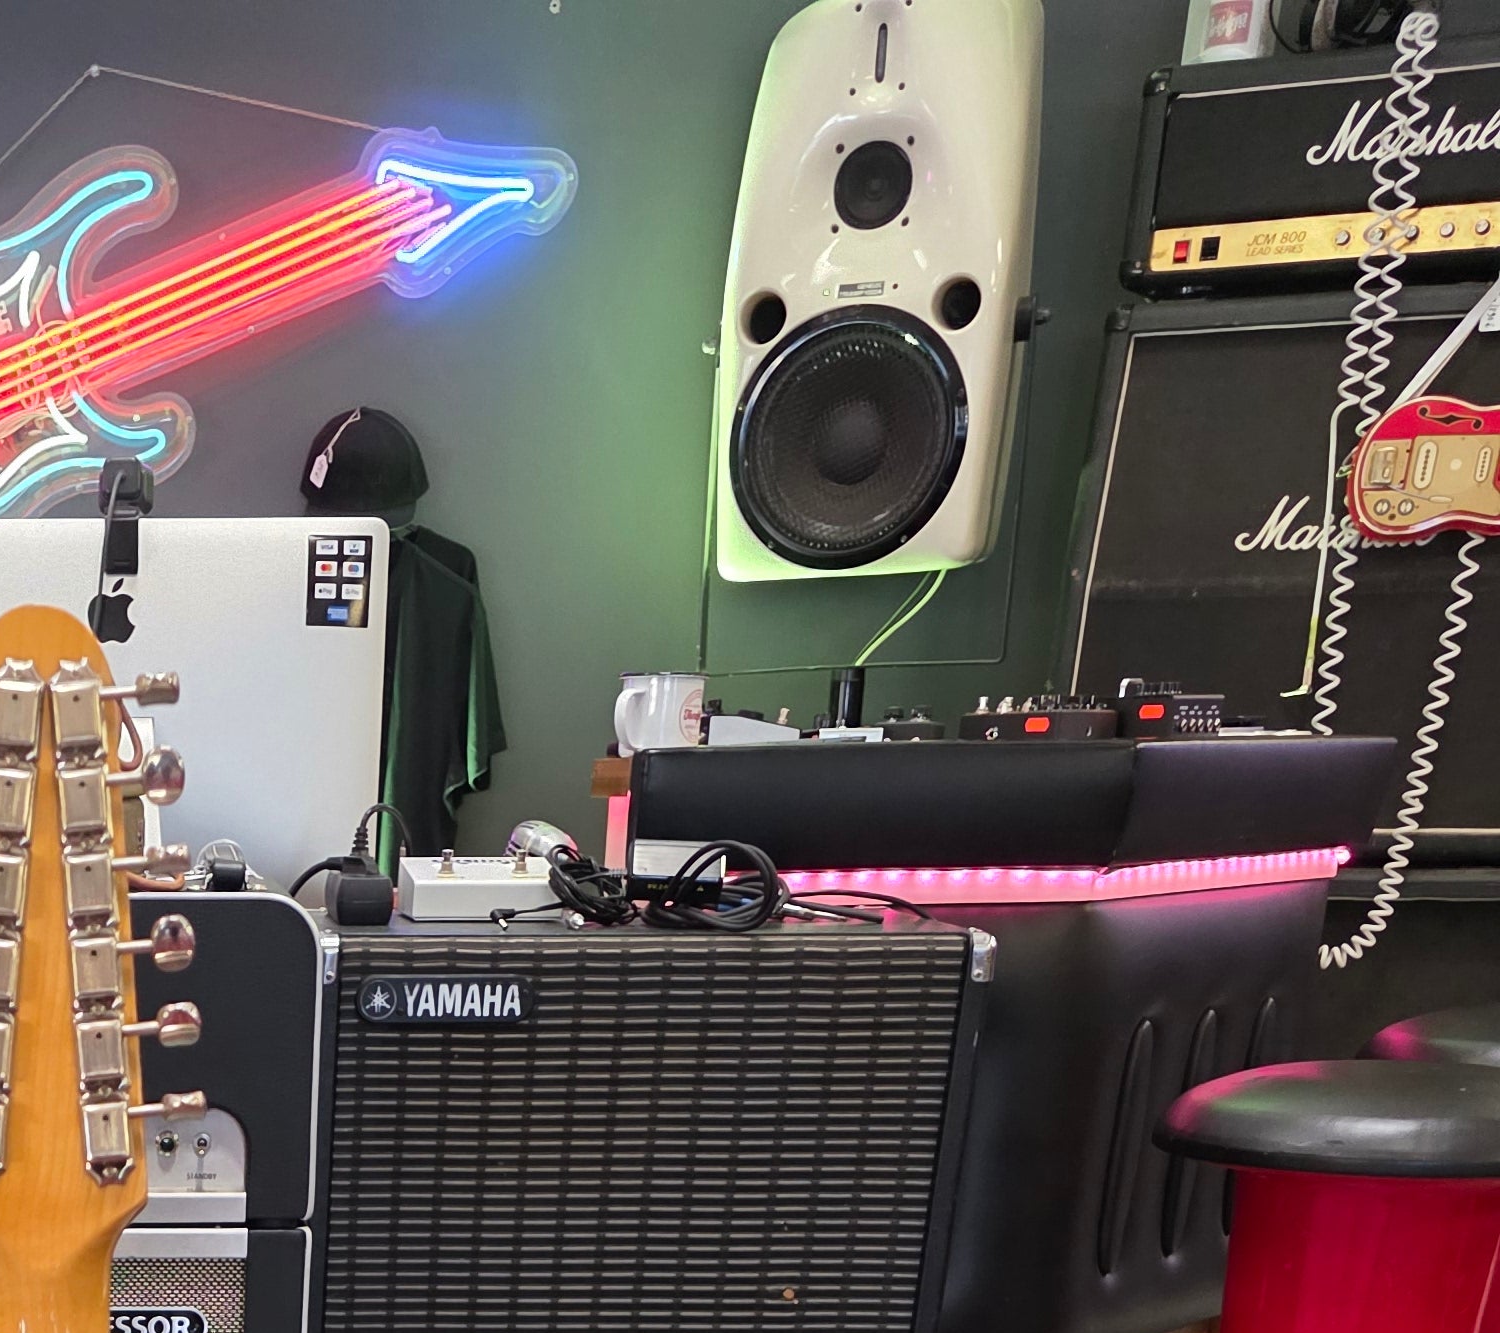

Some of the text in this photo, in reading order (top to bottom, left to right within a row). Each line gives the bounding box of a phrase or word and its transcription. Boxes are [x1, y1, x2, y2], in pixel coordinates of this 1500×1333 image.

[1306, 98, 1500, 166] Marshal
[1247, 231, 1307, 247] JCM 800
[1246, 243, 1304, 257] LEAD SERIES
[403, 983, 522, 1017] YAMAHA
[186, 1172, 217, 1180] STANDBY
